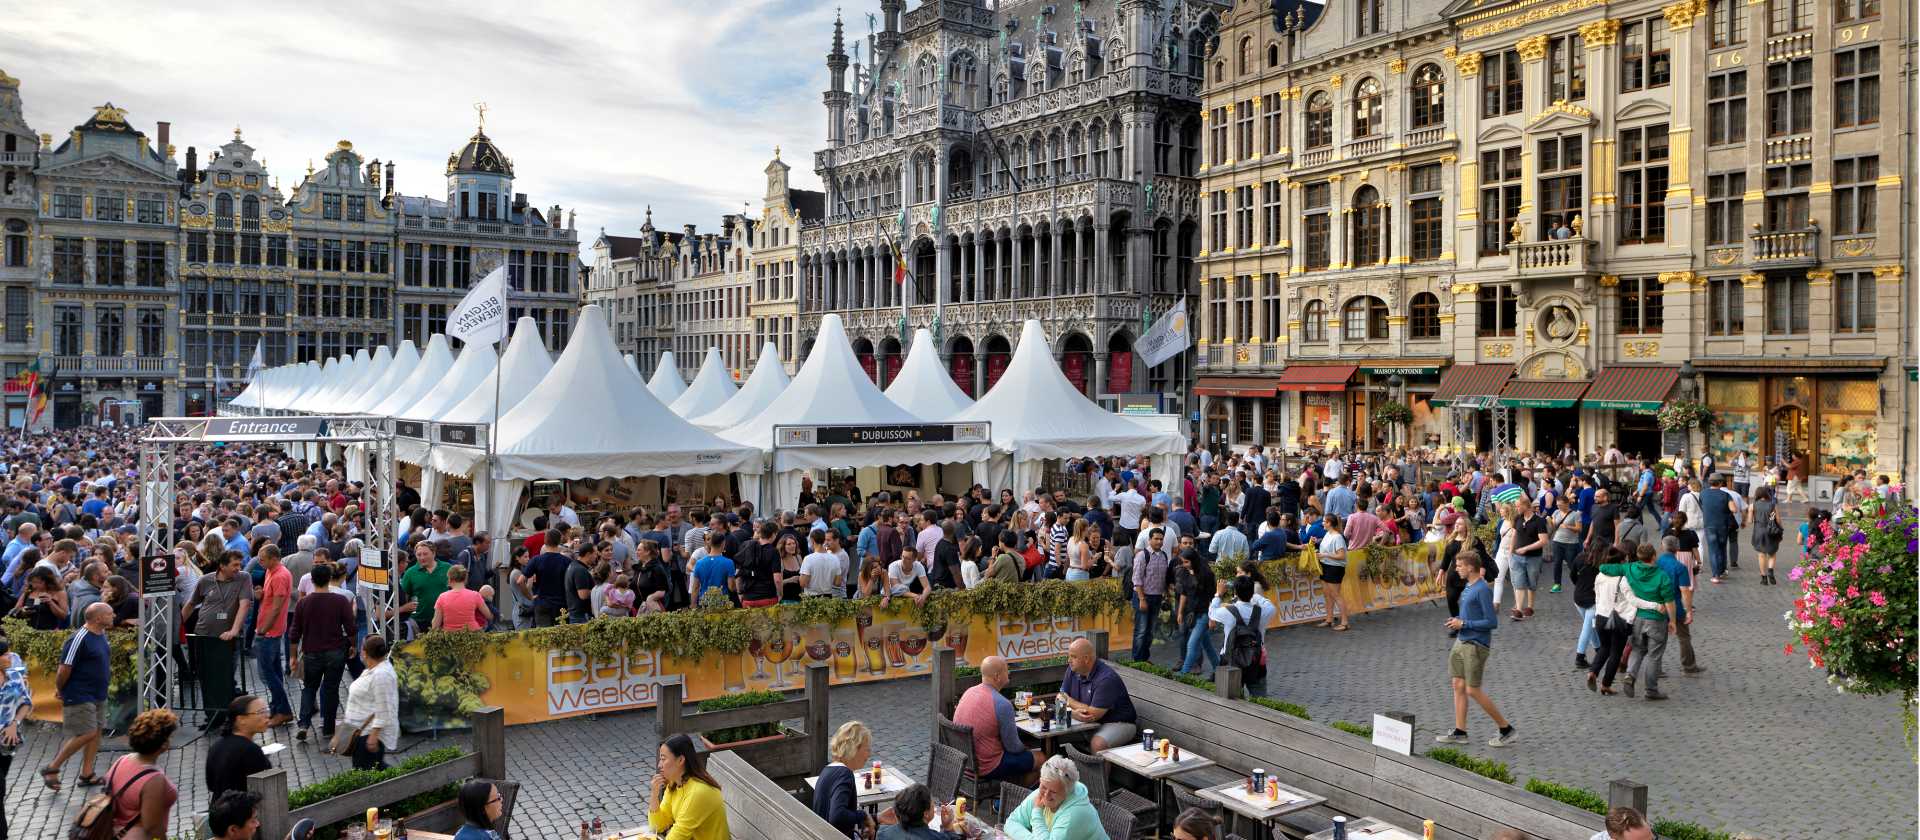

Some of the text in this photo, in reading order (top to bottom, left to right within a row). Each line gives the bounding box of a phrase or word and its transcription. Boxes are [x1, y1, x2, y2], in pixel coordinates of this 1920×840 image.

[1715, 25, 1870, 67] 16 97
[228, 421, 298, 434] Entrance
[862, 430, 913, 440] DUBUISSON
[547, 677, 658, 711] Weeken
